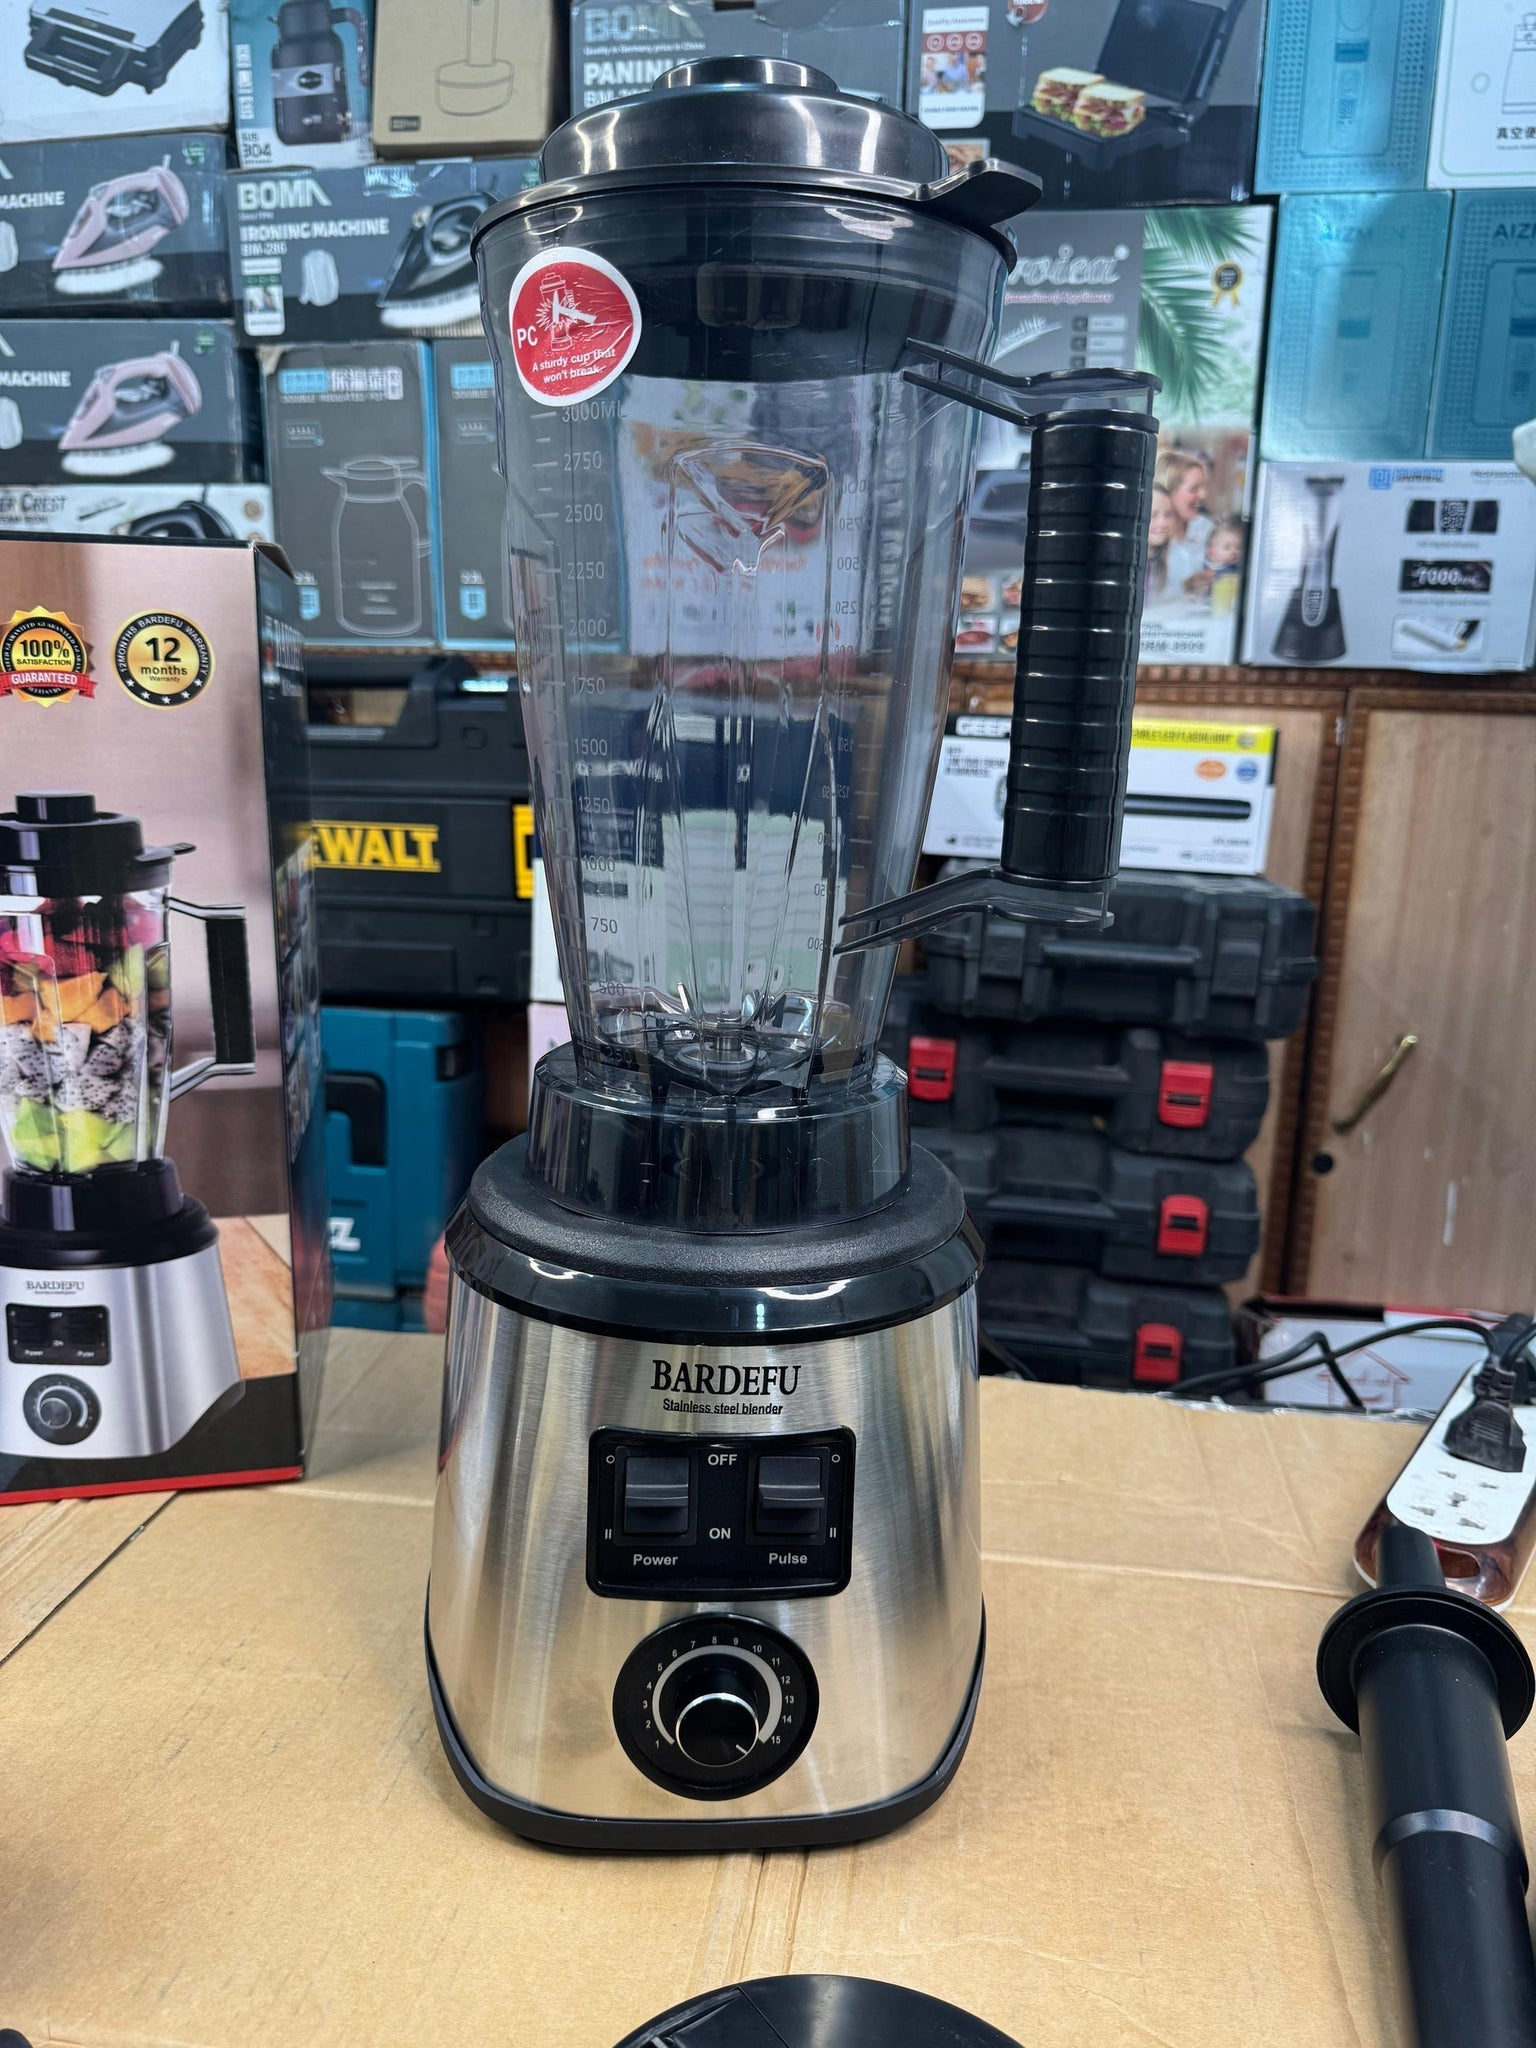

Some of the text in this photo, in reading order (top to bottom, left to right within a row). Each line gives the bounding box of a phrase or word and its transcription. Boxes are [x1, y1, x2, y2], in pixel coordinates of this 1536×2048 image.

[240, 217, 390, 242] IRONING MACHINE
[516, 325, 539, 349] PC
[532, 348, 617, 372] A sturdy cup that
[543, 368, 568, 384] won't
[563, 450, 602, 471] 2750
[564, 503, 603, 522] 2500
[567, 561, 605, 580] 2250
[569, 618, 606, 637] 2000
[20, 639, 70, 658] 100%
[138, 616, 183, 628] BARDEFU
[185, 626, 209, 676] WARRANTY
[145, 637, 182, 663] 12
[16, 658, 72, 666] SATISFACTION
[140, 666, 188, 676] months
[11, 672, 78, 685] GUARANTEED
[571, 676, 606, 695] 1750
[574, 738, 608, 756] 1500
[578, 795, 611, 815] 1250
[583, 854, 616, 873] 1000
[591, 916, 618, 934] 750
[598, 981, 625, 997] 500
[25, 1280, 85, 1291] BARDEFU
[650, 1359, 802, 1396] BARDEFU
[662, 1398, 784, 1415] Stainless steel blender
[707, 1453, 738, 1466] OFF
[709, 1527, 732, 1540] ON
[633, 1552, 808, 1566] Power Pulse
[690, 1640, 696, 1649] 7
[712, 1636, 718, 1644] 8
[733, 1637, 739, 1646] 9
[672, 1649, 678, 1657] 6
[753, 1645, 763, 1653] 10
[657, 1663, 663, 1672] 5
[771, 1657, 781, 1666] 11
[646, 1681, 652, 1690] 4
[780, 1675, 791, 1684] 12
[642, 1700, 648, 1708] 3
[784, 1695, 795, 1704] 13
[645, 1720, 651, 1728] 2
[782, 1715, 793, 1724] 14
[655, 1740, 660, 1748] 1
[770, 1735, 781, 1744] 15
